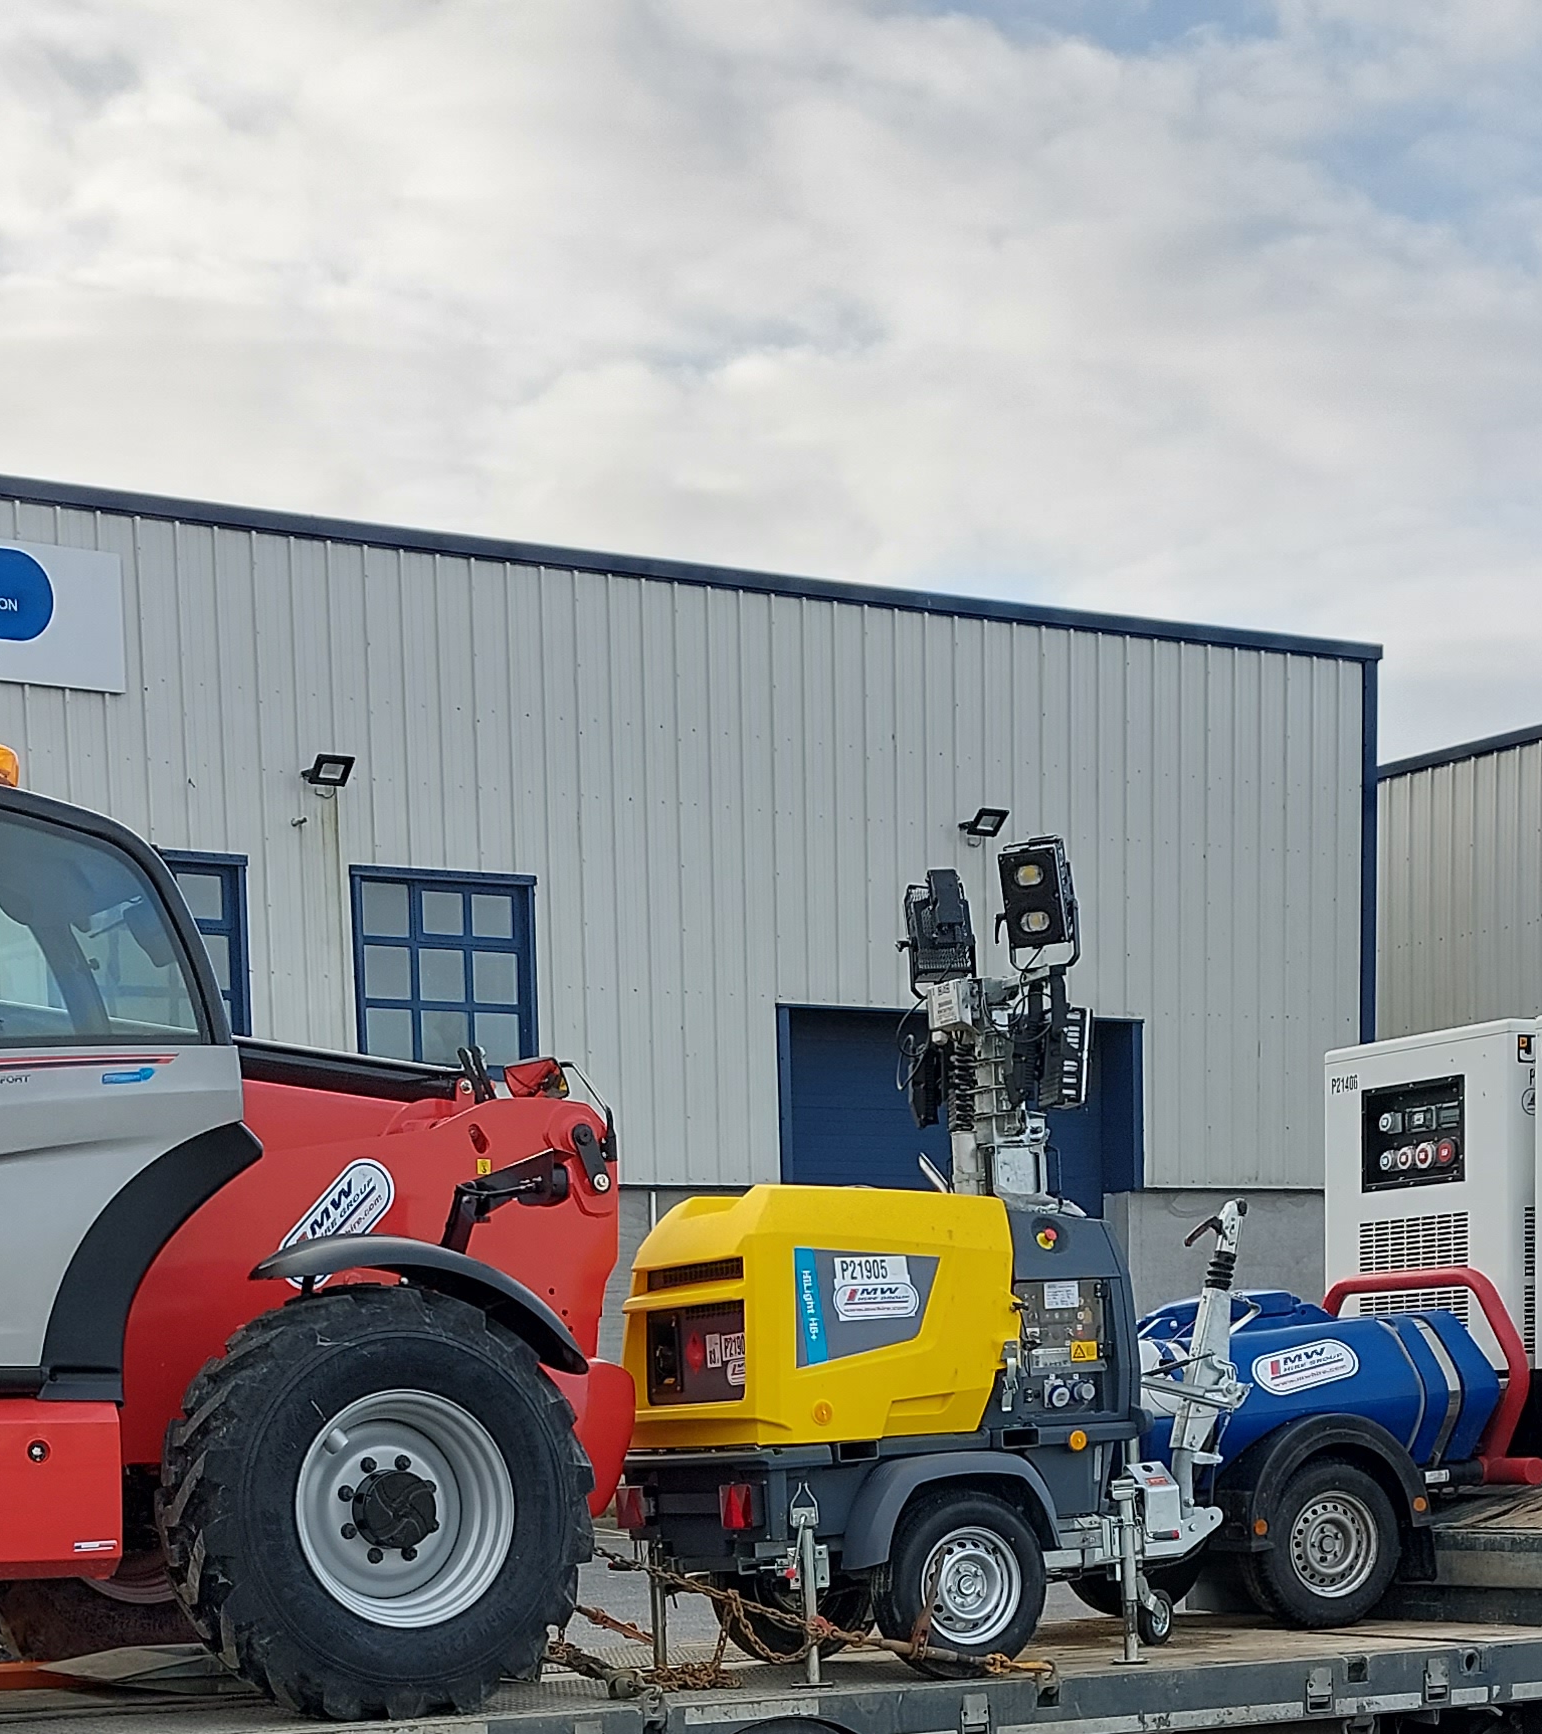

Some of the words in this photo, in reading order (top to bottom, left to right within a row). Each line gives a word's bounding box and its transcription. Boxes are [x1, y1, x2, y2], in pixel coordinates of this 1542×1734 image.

[309, 1177, 353, 1238] MW
[339, 1177, 373, 1218] GROUP
[840, 1259, 888, 1281] P21905
[859, 1286, 900, 1296] MW
[1282, 1346, 1326, 1366] MW
